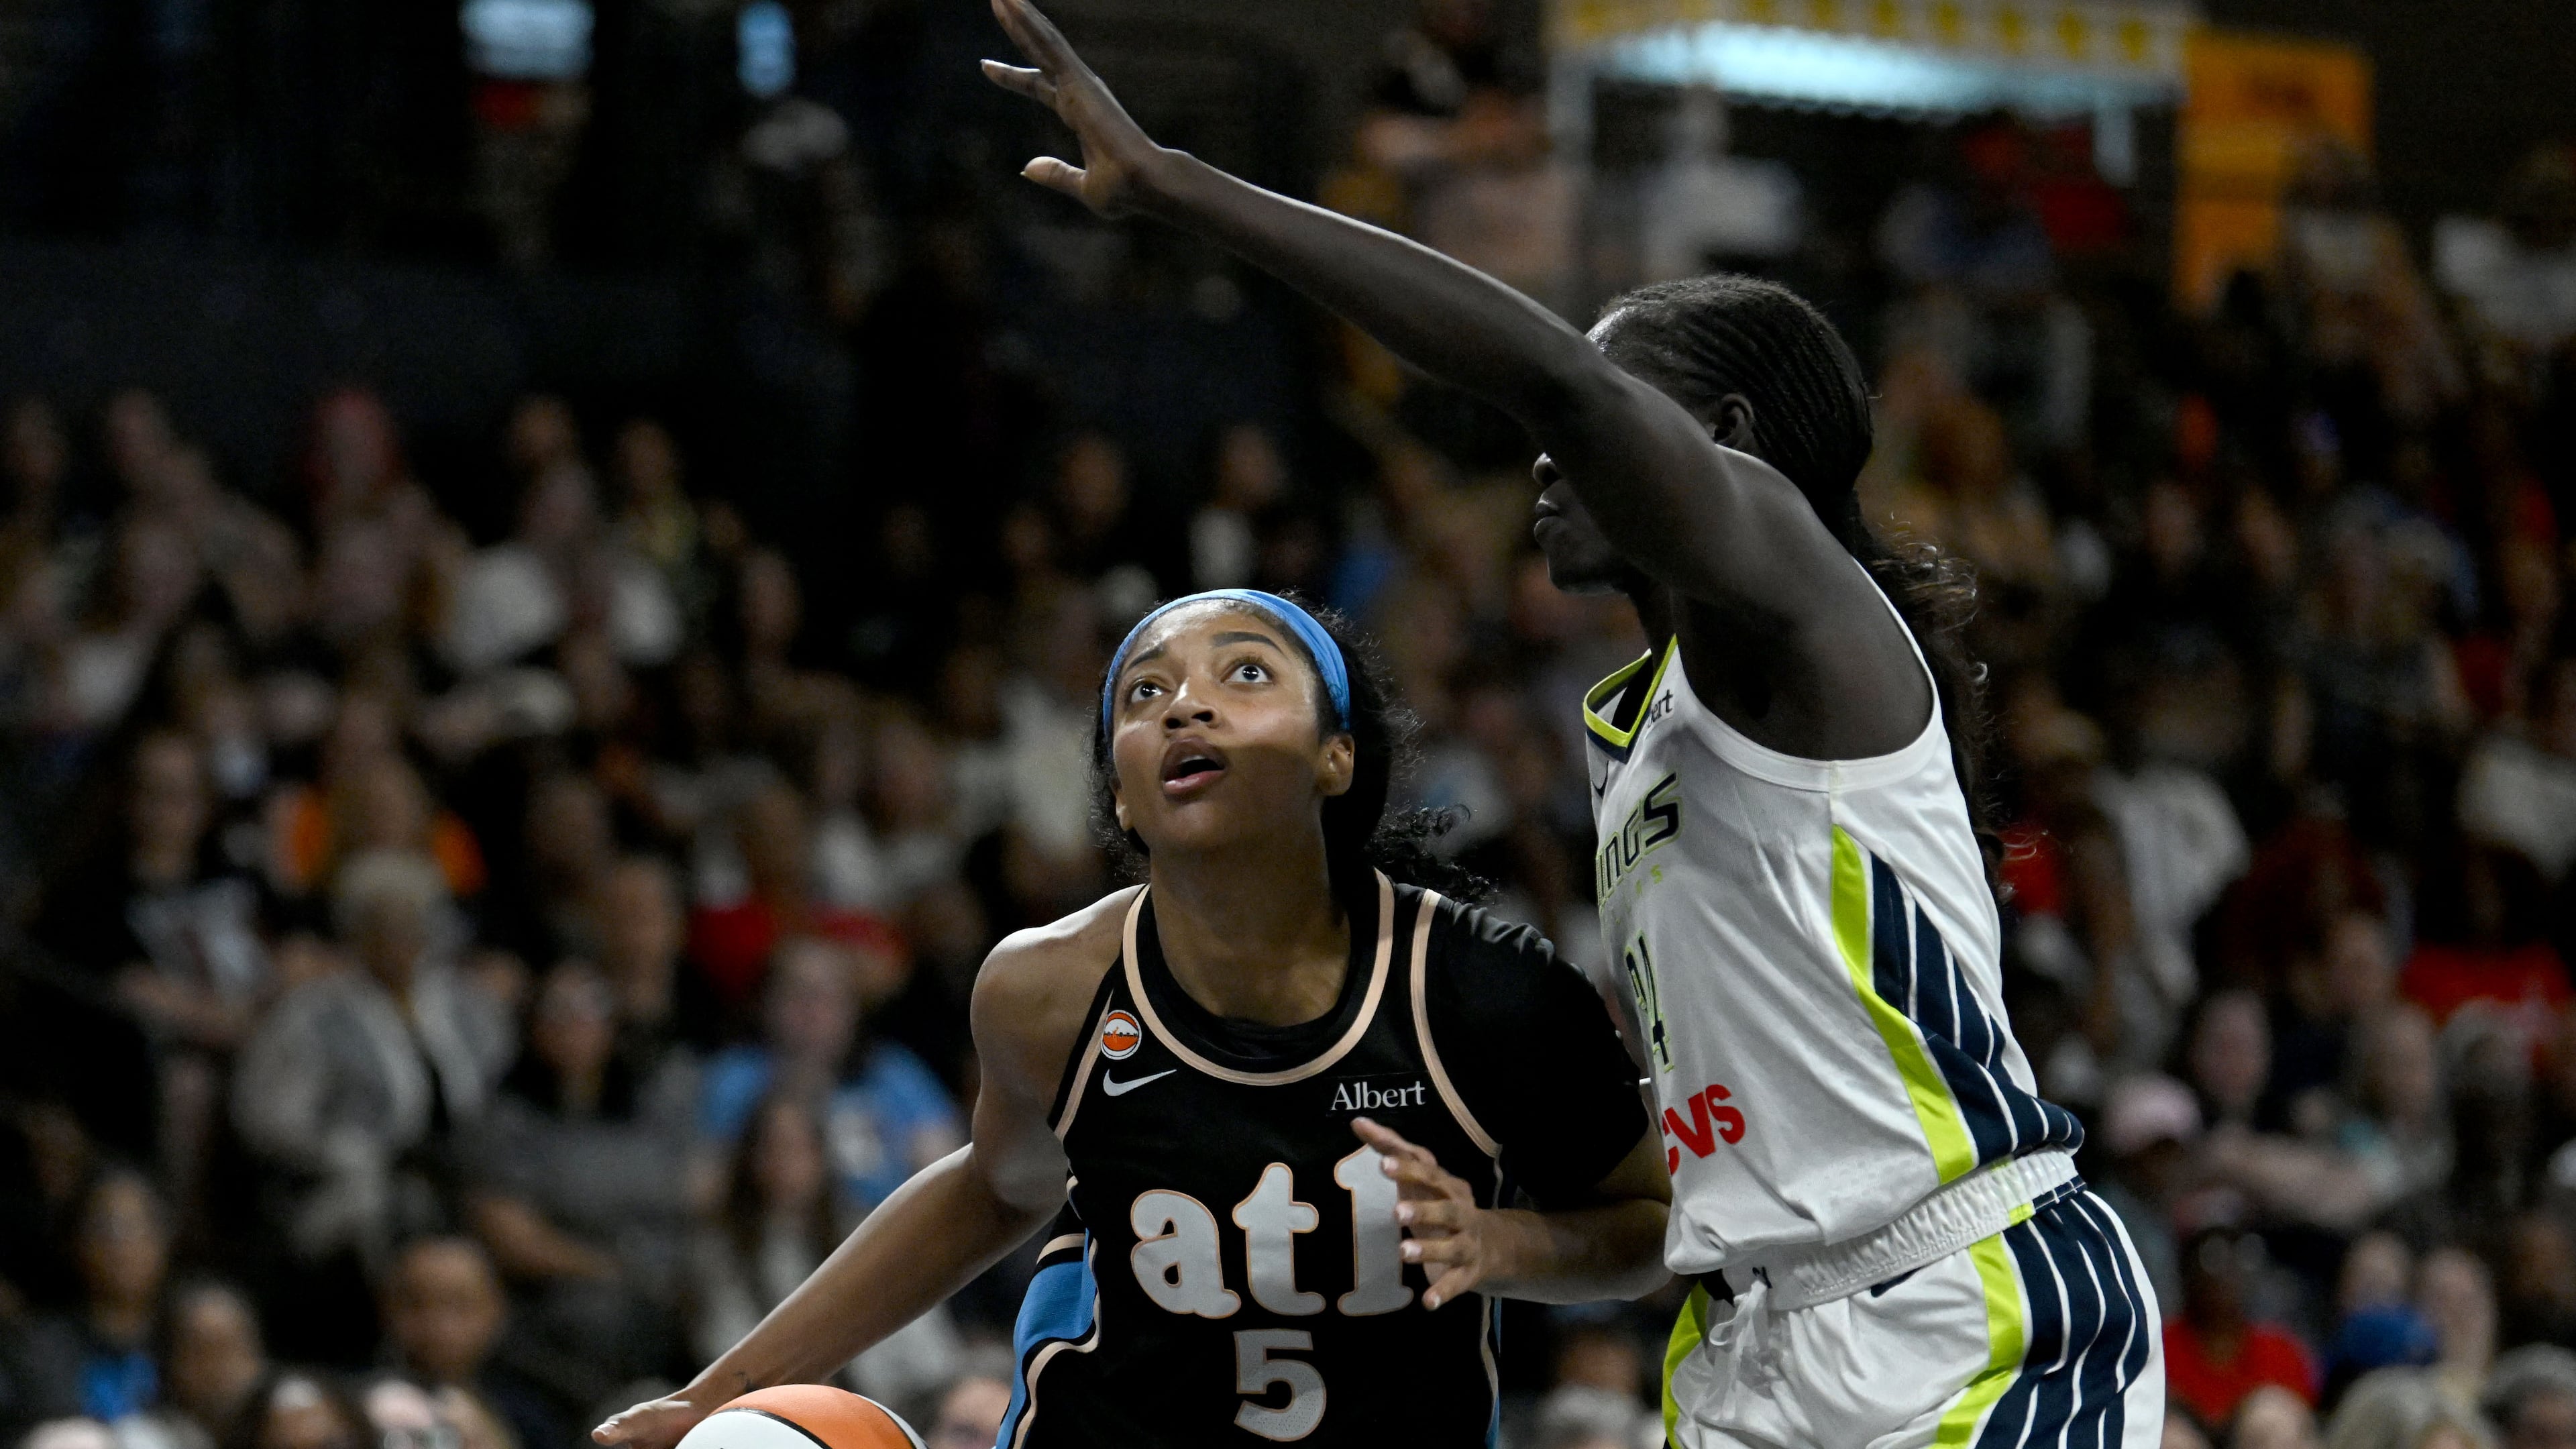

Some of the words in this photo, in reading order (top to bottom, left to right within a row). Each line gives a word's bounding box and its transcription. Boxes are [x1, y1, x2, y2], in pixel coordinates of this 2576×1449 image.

[1648, 689, 1674, 728] ert
[1595, 770, 1682, 906] INGS
[1330, 1080, 1426, 1112] Albert
[1130, 1144, 1414, 1319] atl
[1232, 1328, 1327, 1442] 5
